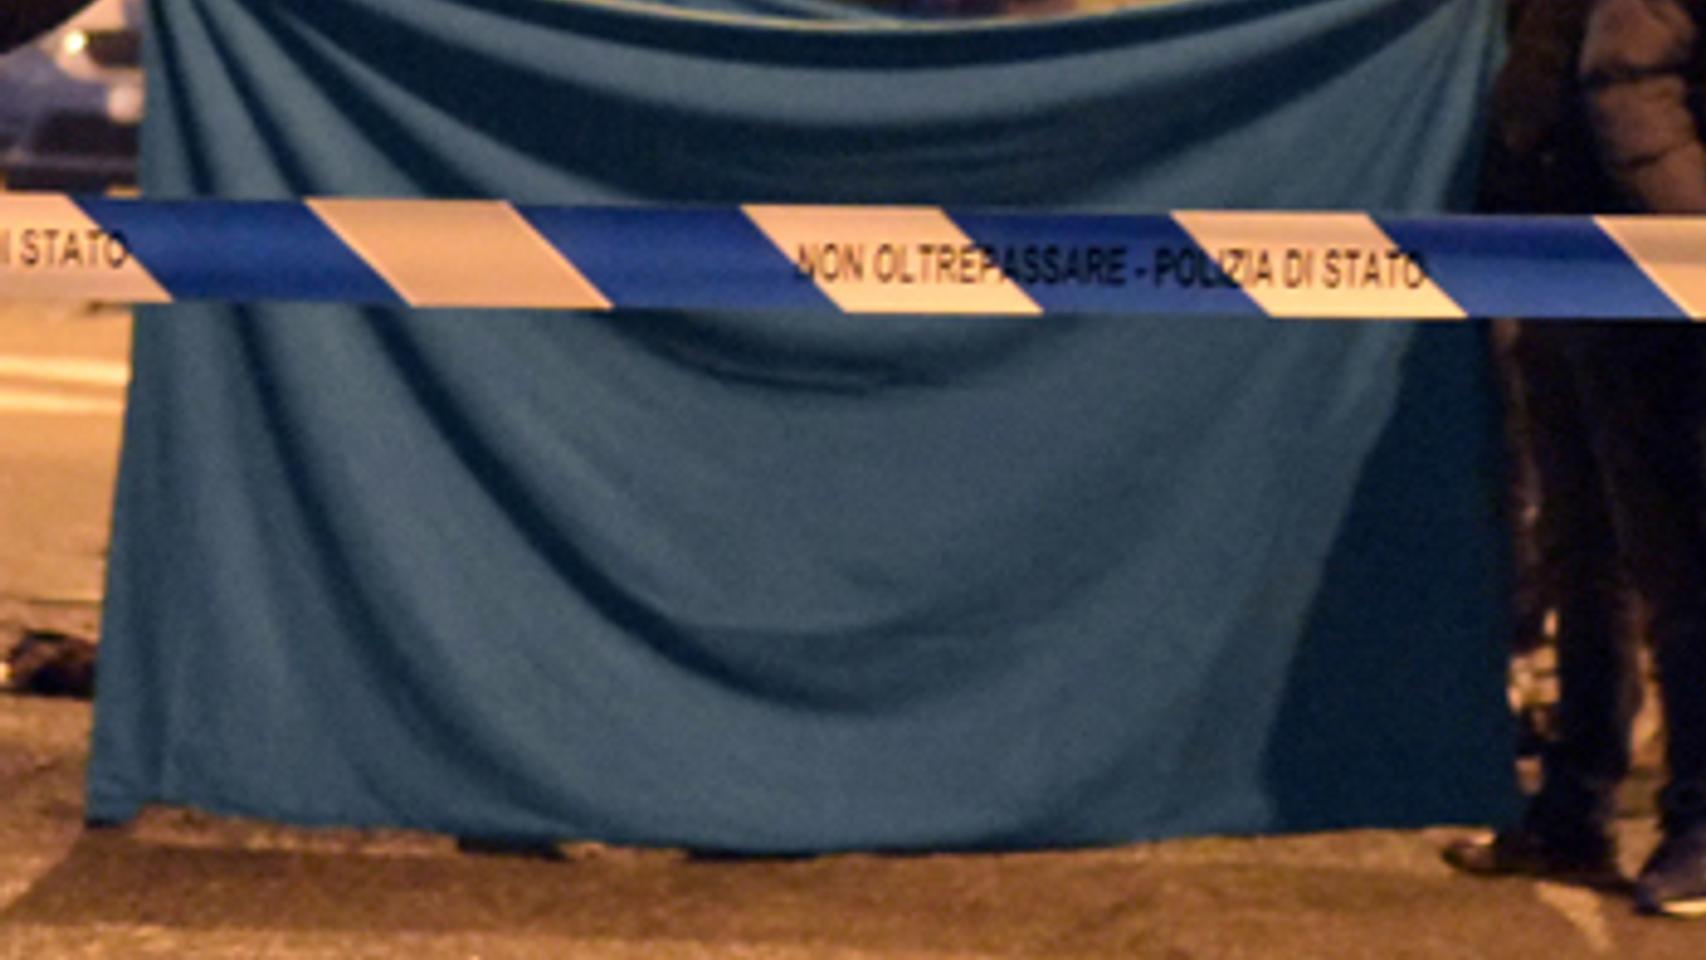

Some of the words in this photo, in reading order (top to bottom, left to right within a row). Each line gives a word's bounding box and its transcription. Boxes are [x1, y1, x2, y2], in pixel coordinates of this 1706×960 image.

[20, 228, 127, 269] STATO
[796, 243, 863, 282] NON
[873, 243, 1127, 285] OLTREPASSARE
[1154, 246, 1273, 289] POLIZIA
[1283, 248, 1313, 289] DI
[1323, 248, 1424, 289] STATO
